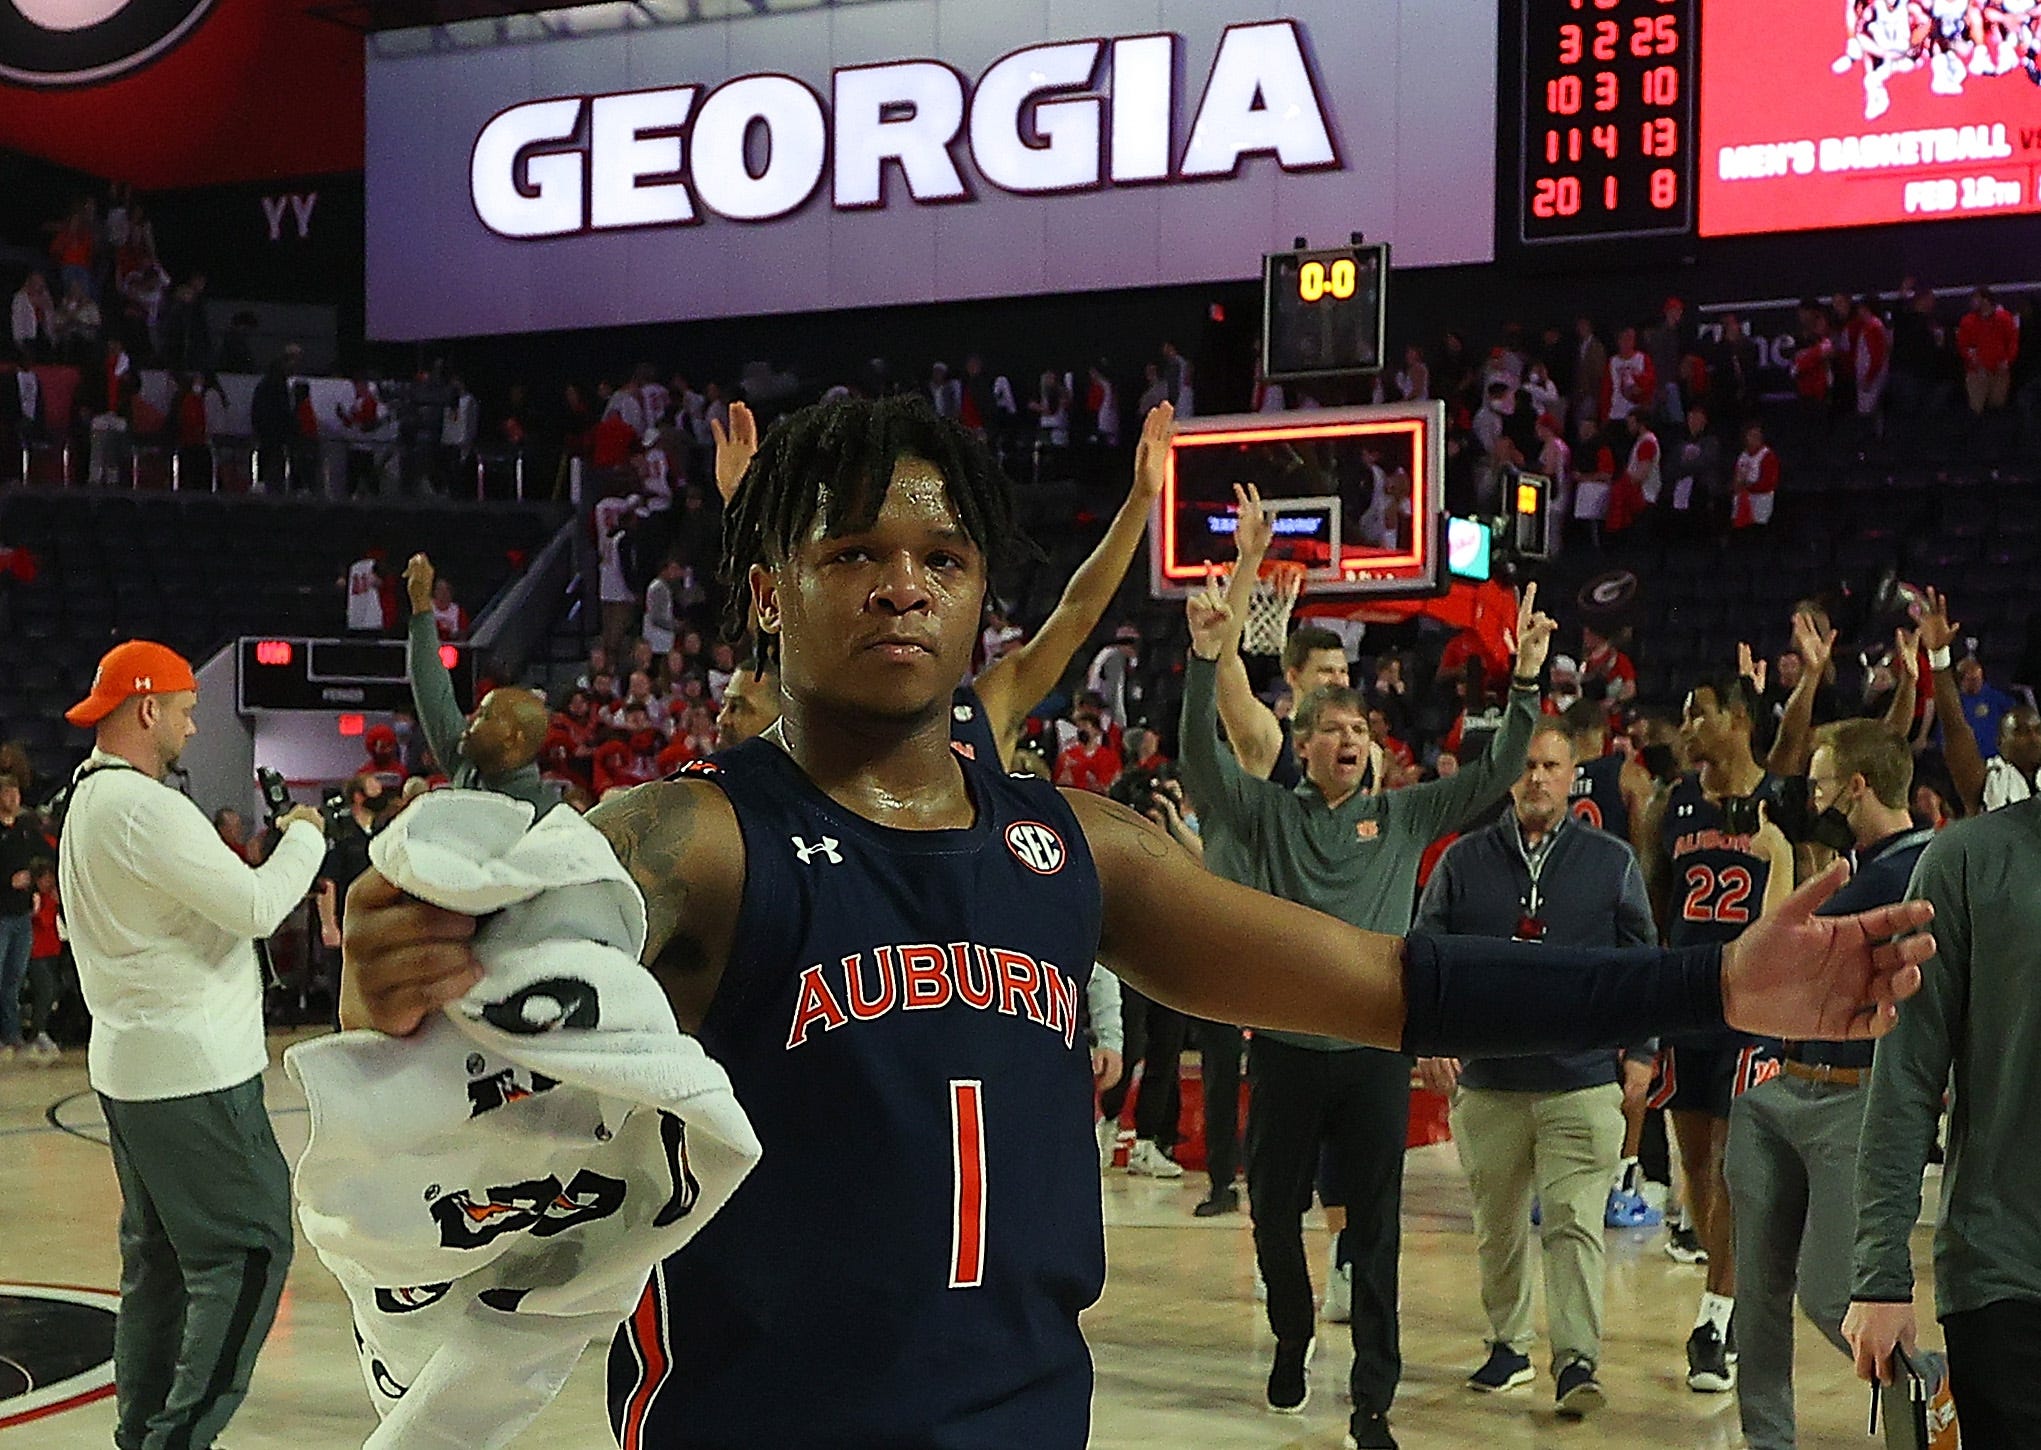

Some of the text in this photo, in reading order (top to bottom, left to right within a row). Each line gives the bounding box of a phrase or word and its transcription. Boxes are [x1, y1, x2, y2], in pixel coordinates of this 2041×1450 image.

[1559, 14, 1679, 65] 3 2 25
[1546, 65, 1679, 115] 10 3 10
[470, 22, 1336, 237] GEORGIA
[1546, 117, 1678, 164] 11 4 13
[1718, 140, 1816, 181] MEN'S
[1818, 122, 2012, 172] BASKETBALL
[262, 192, 317, 240] YY
[1532, 168, 1677, 218] 20 1 8
[1904, 178, 1958, 213] FEB
[1008, 824, 1063, 871] SEC
[1682, 864, 1753, 923] 22
[785, 941, 1078, 1050] AUBURN
[947, 1079, 988, 1289] 1
